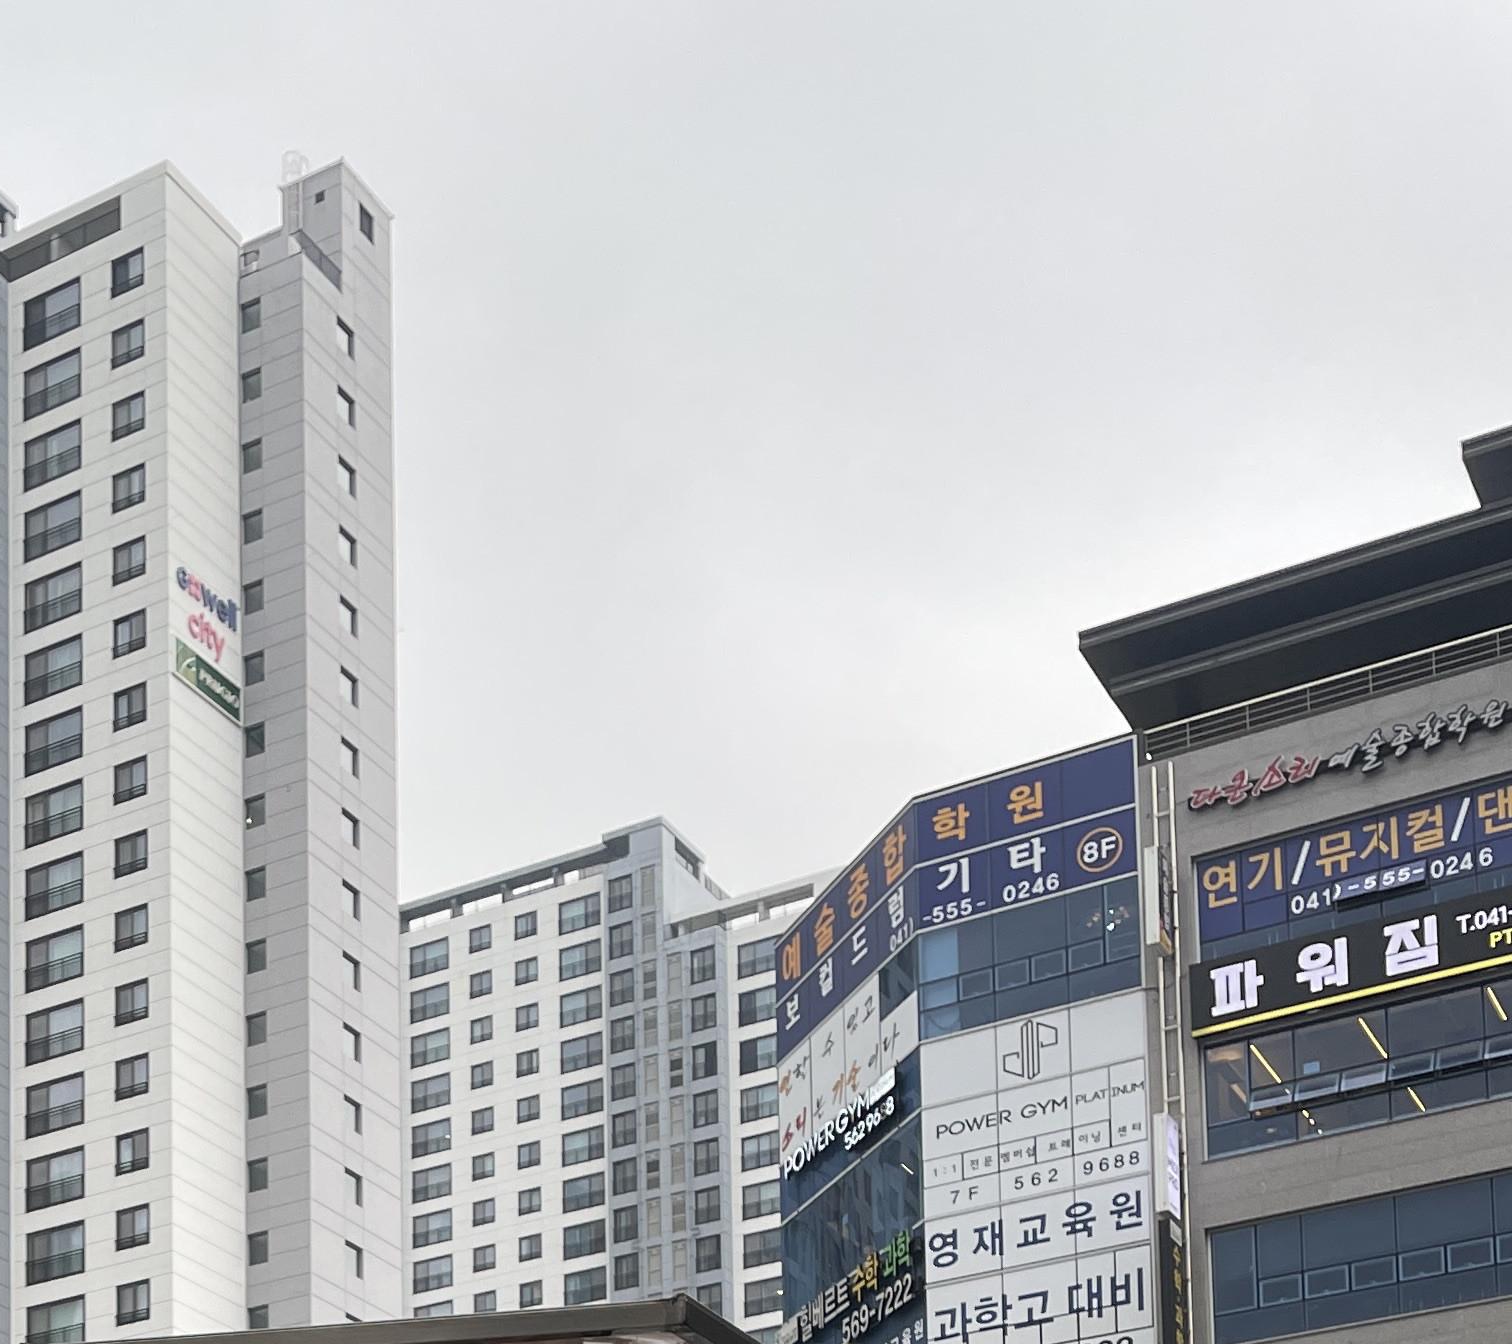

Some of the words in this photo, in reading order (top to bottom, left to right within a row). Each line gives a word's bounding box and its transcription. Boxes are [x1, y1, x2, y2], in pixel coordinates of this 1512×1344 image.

[937, 837, 1046, 894] 기타
[1081, 836, 1117, 864] 8F
[1210, 915, 1439, 1017] 파워짐
[784, 1123, 835, 1180] POWER
[835, 1090, 870, 1134] GYM
[936, 1109, 1011, 1139] POWER
[1020, 1096, 1068, 1119] GYM
[1075, 1080, 1145, 1105] PLATINUM
[1083, 1151, 1140, 1176] 9688
[928, 1190, 1143, 1268] 영재교육원
[842, 1273, 913, 1344] 569-7222
[934, 1289, 1054, 1344] 과학고
[1068, 1267, 1144, 1319] 대비
